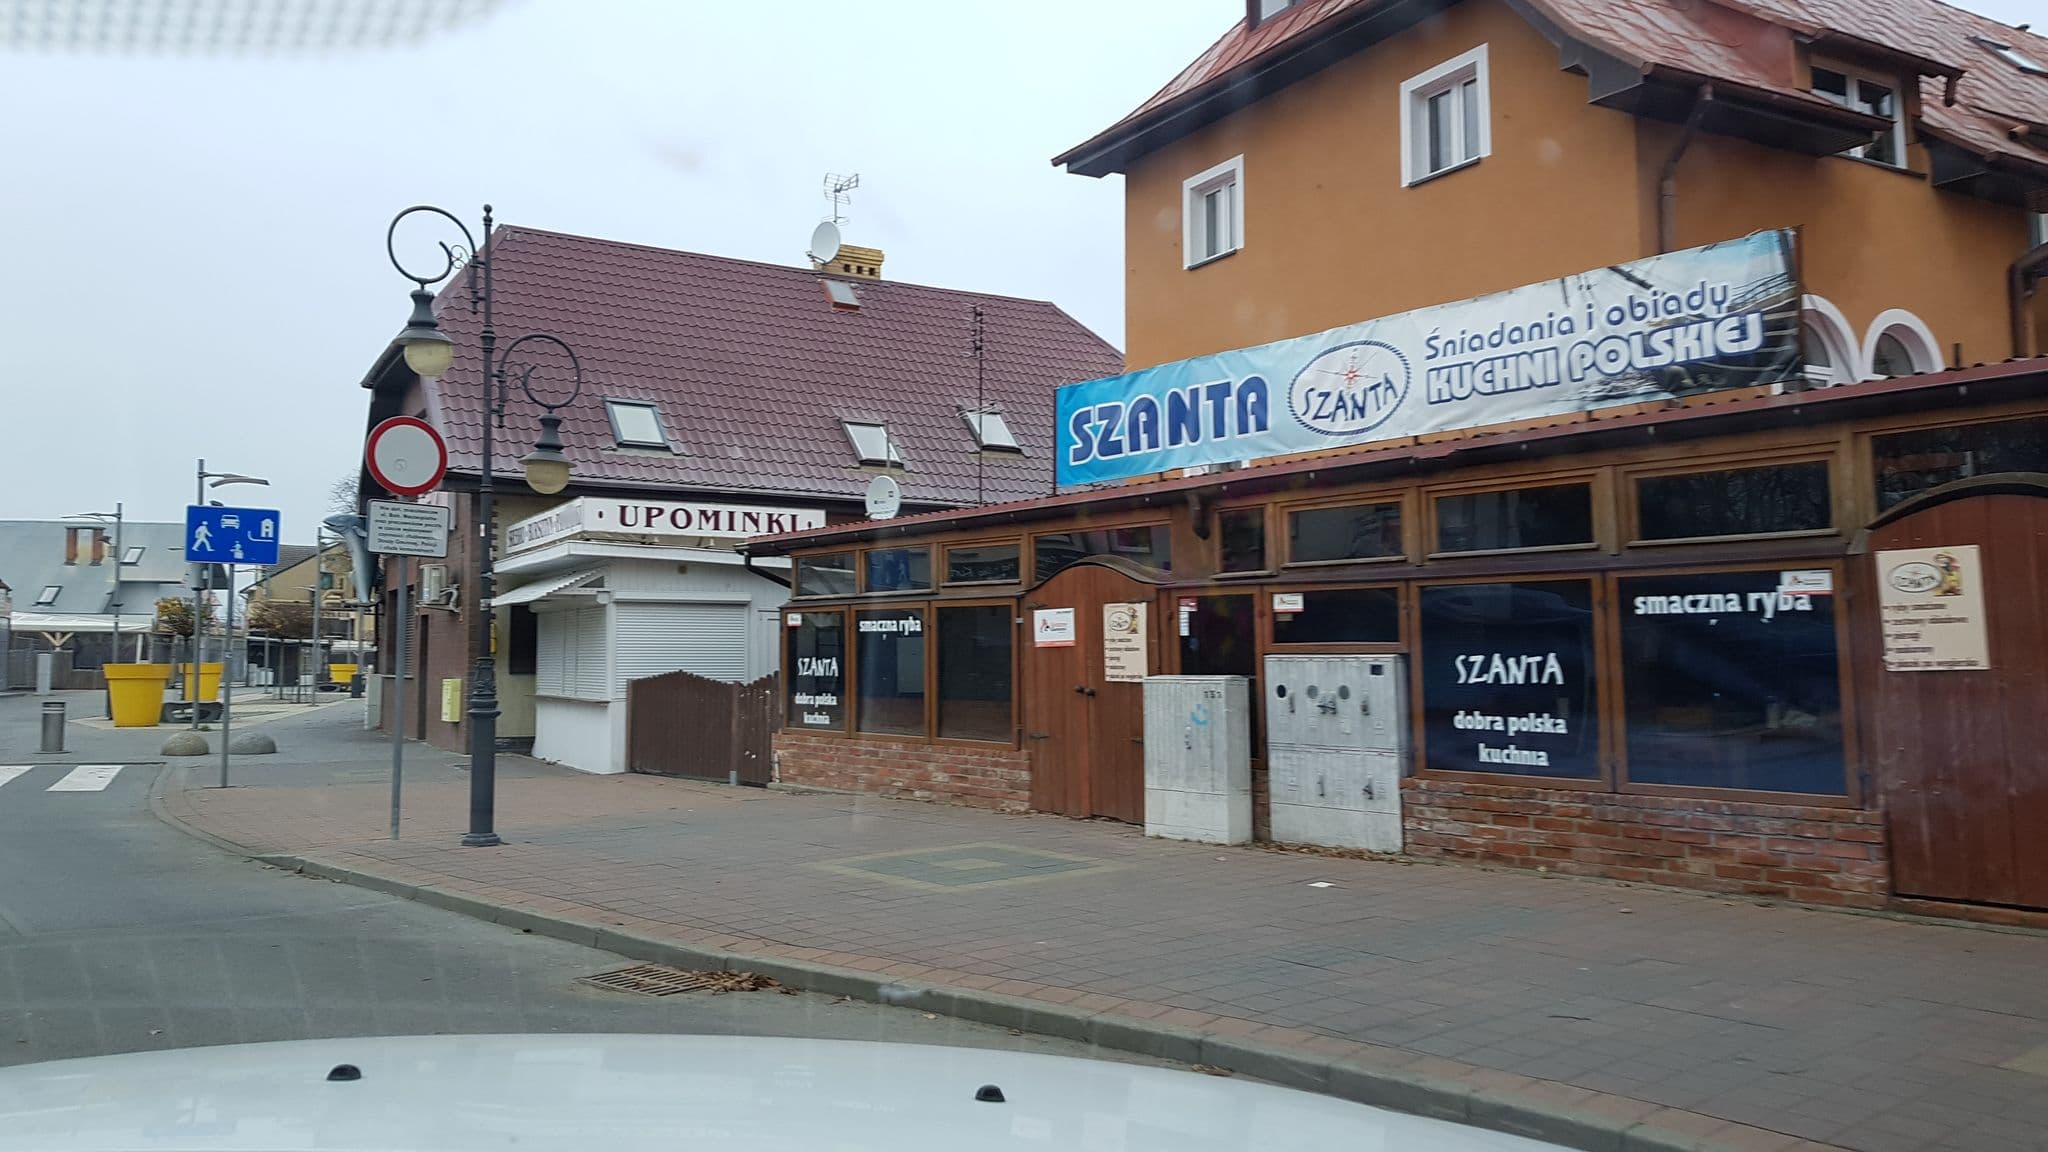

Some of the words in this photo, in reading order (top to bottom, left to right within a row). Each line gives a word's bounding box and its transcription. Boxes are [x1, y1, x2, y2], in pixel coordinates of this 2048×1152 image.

[1425, 312, 1575, 361] Śniadania
[1586, 303, 1593, 331] i
[1606, 280, 1730, 327] obiady
[1426, 346, 1560, 404] KUCHNI
[1568, 311, 1765, 383] POLSKIEJ
[1301, 372, 1399, 423] SZANTA
[1071, 375, 1270, 465] SZANTA
[618, 505, 800, 534] UPOMINKI
[1633, 593, 1743, 615] smaczna
[1747, 585, 1813, 620] ryba
[859, 619, 898, 632] smaczna
[899, 616, 922, 636] ryba
[797, 657, 839, 677] SZANTA
[1454, 652, 1565, 685] SZANTA
[1453, 710, 1505, 731] dobra
[1508, 712, 1569, 737] polska
[1478, 743, 1550, 767] kuchnia
